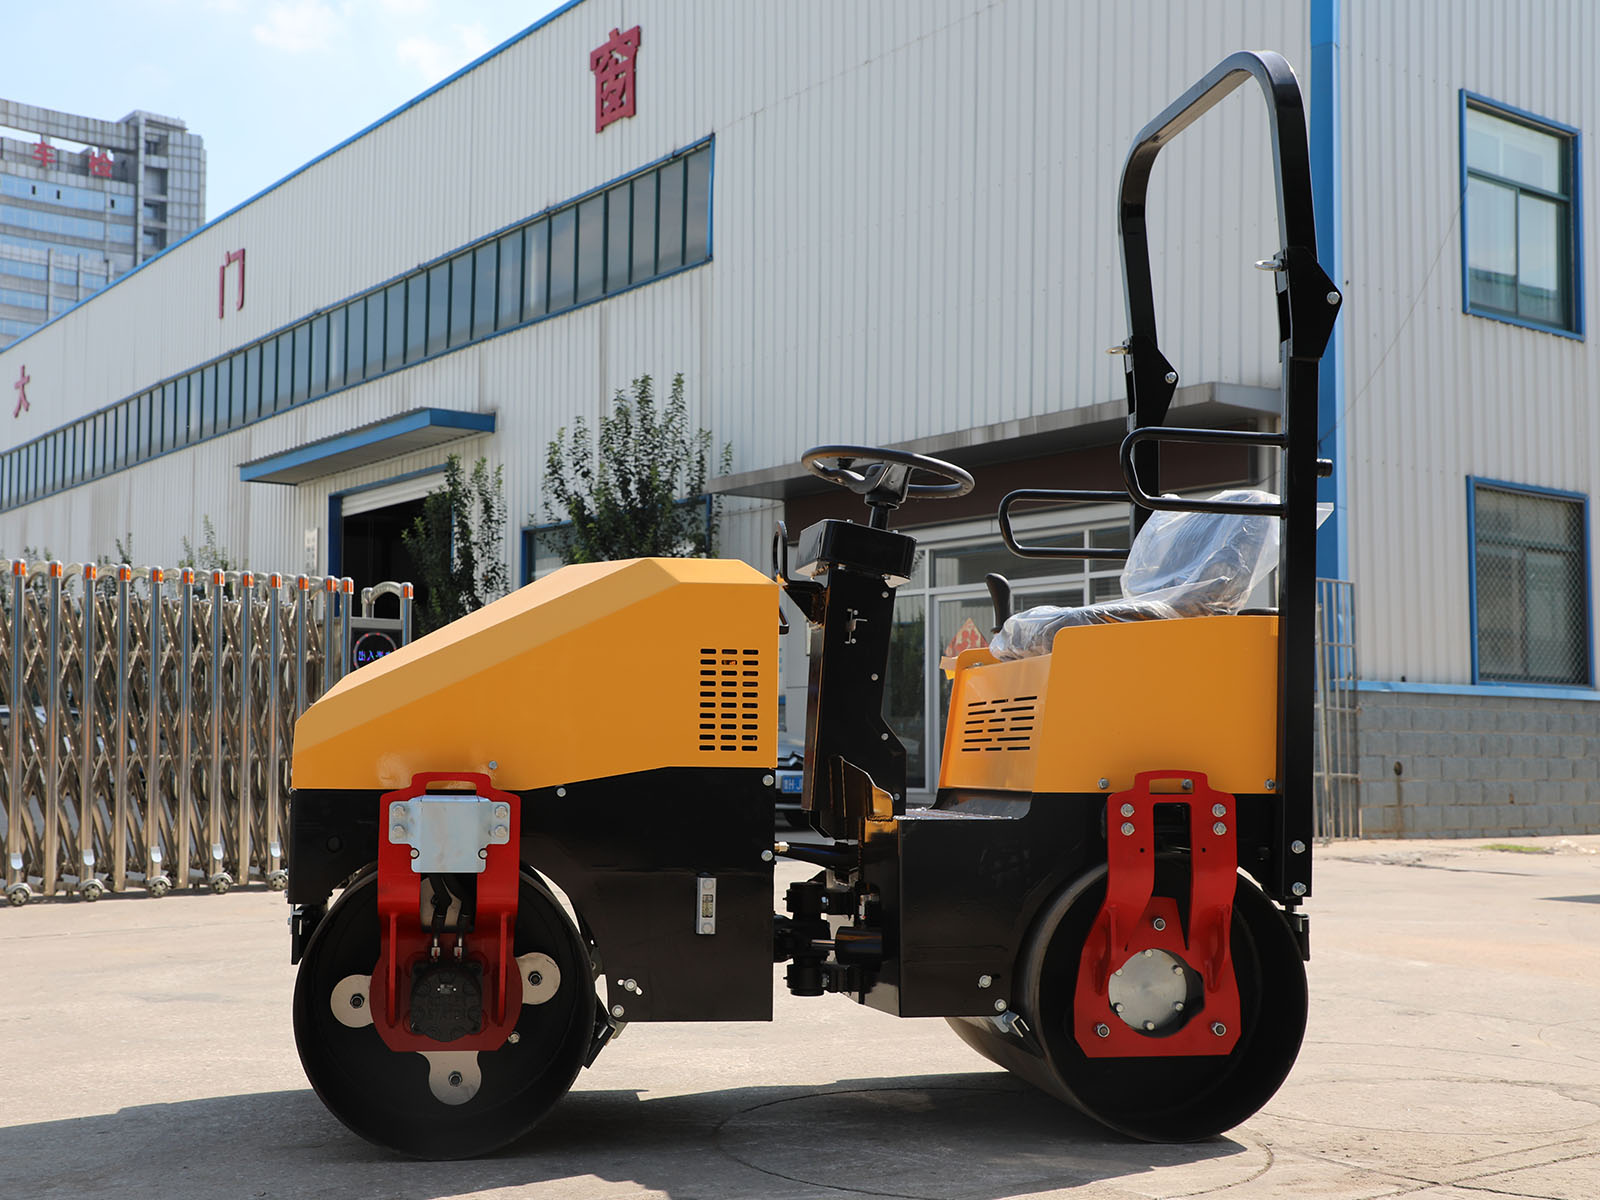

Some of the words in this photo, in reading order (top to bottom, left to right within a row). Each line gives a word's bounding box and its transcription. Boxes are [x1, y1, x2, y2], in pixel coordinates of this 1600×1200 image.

[14, 364, 31, 419] 大
[219, 247, 246, 320] 门
[590, 25, 642, 134] 窗
